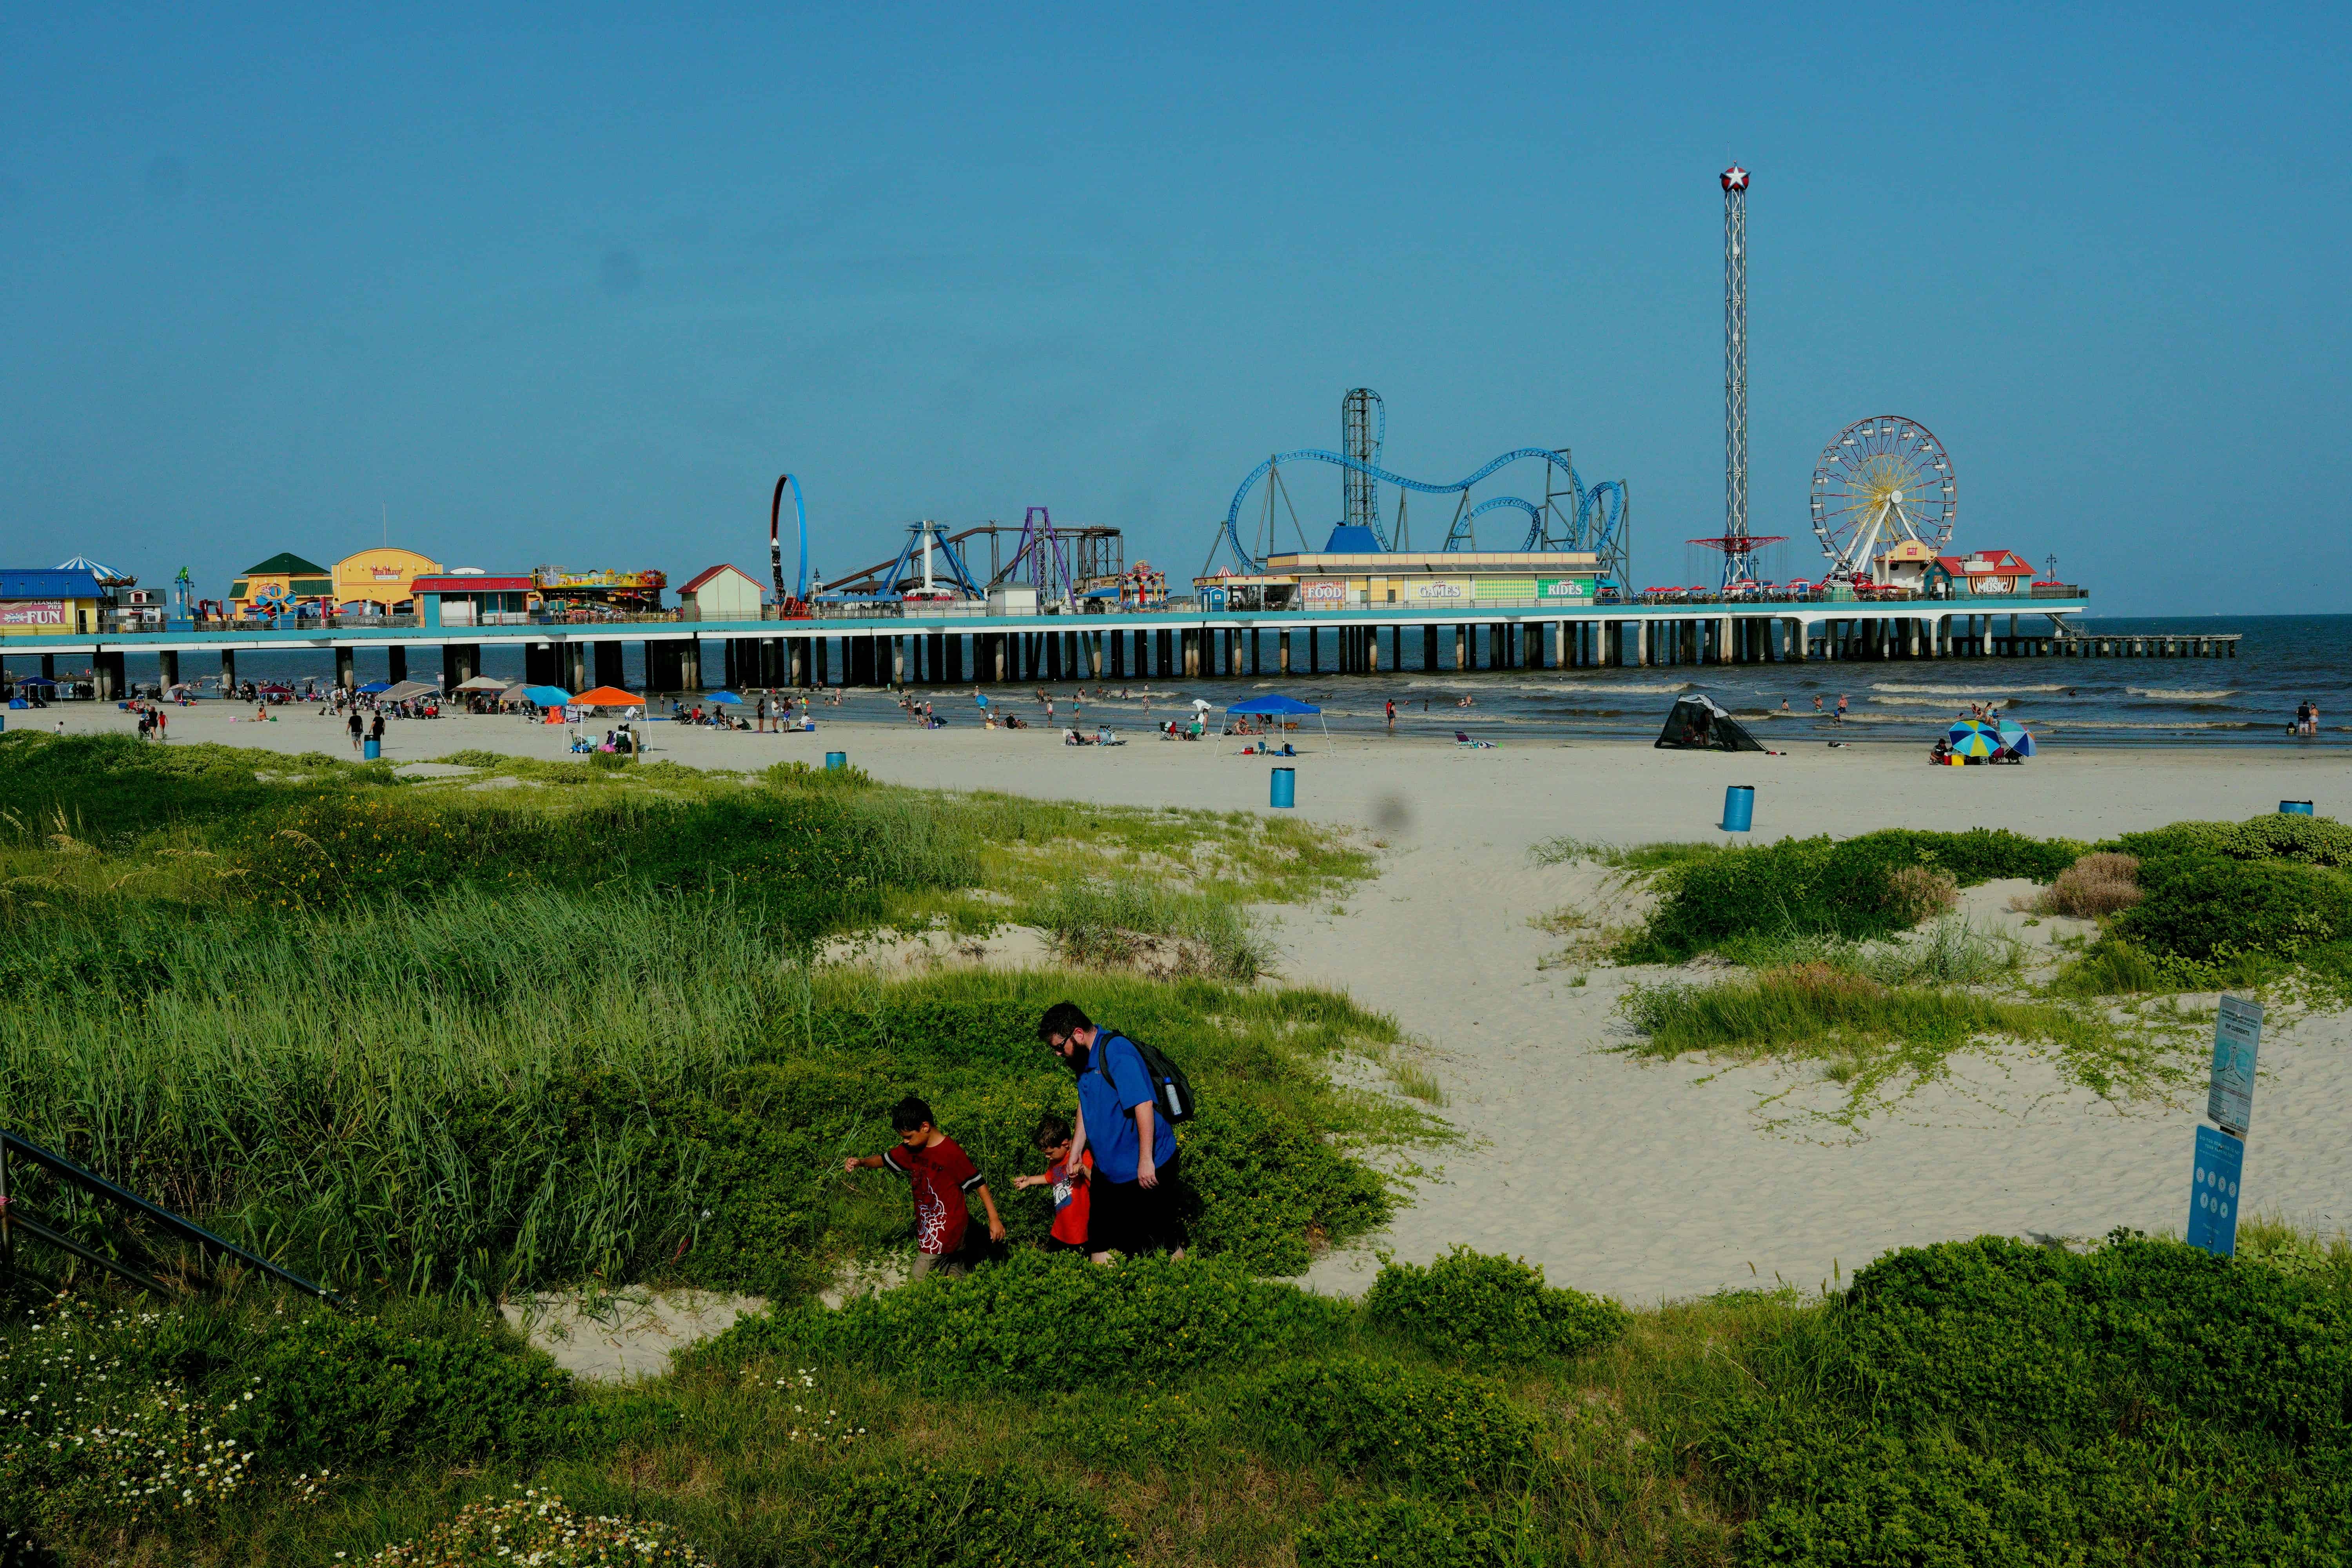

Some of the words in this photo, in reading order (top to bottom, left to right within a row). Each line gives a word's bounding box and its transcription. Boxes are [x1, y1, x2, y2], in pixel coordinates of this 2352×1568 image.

[1307, 587, 1341, 598] FOOD
[1418, 586, 1460, 597] GAMES
[1548, 585, 1583, 595] RIDES
[1977, 582, 2008, 593] MUSIC
[27, 611, 61, 624] FUN
[2231, 1025, 2250, 1036] CURRENTS
[1063, 1179, 1071, 1187] 08
